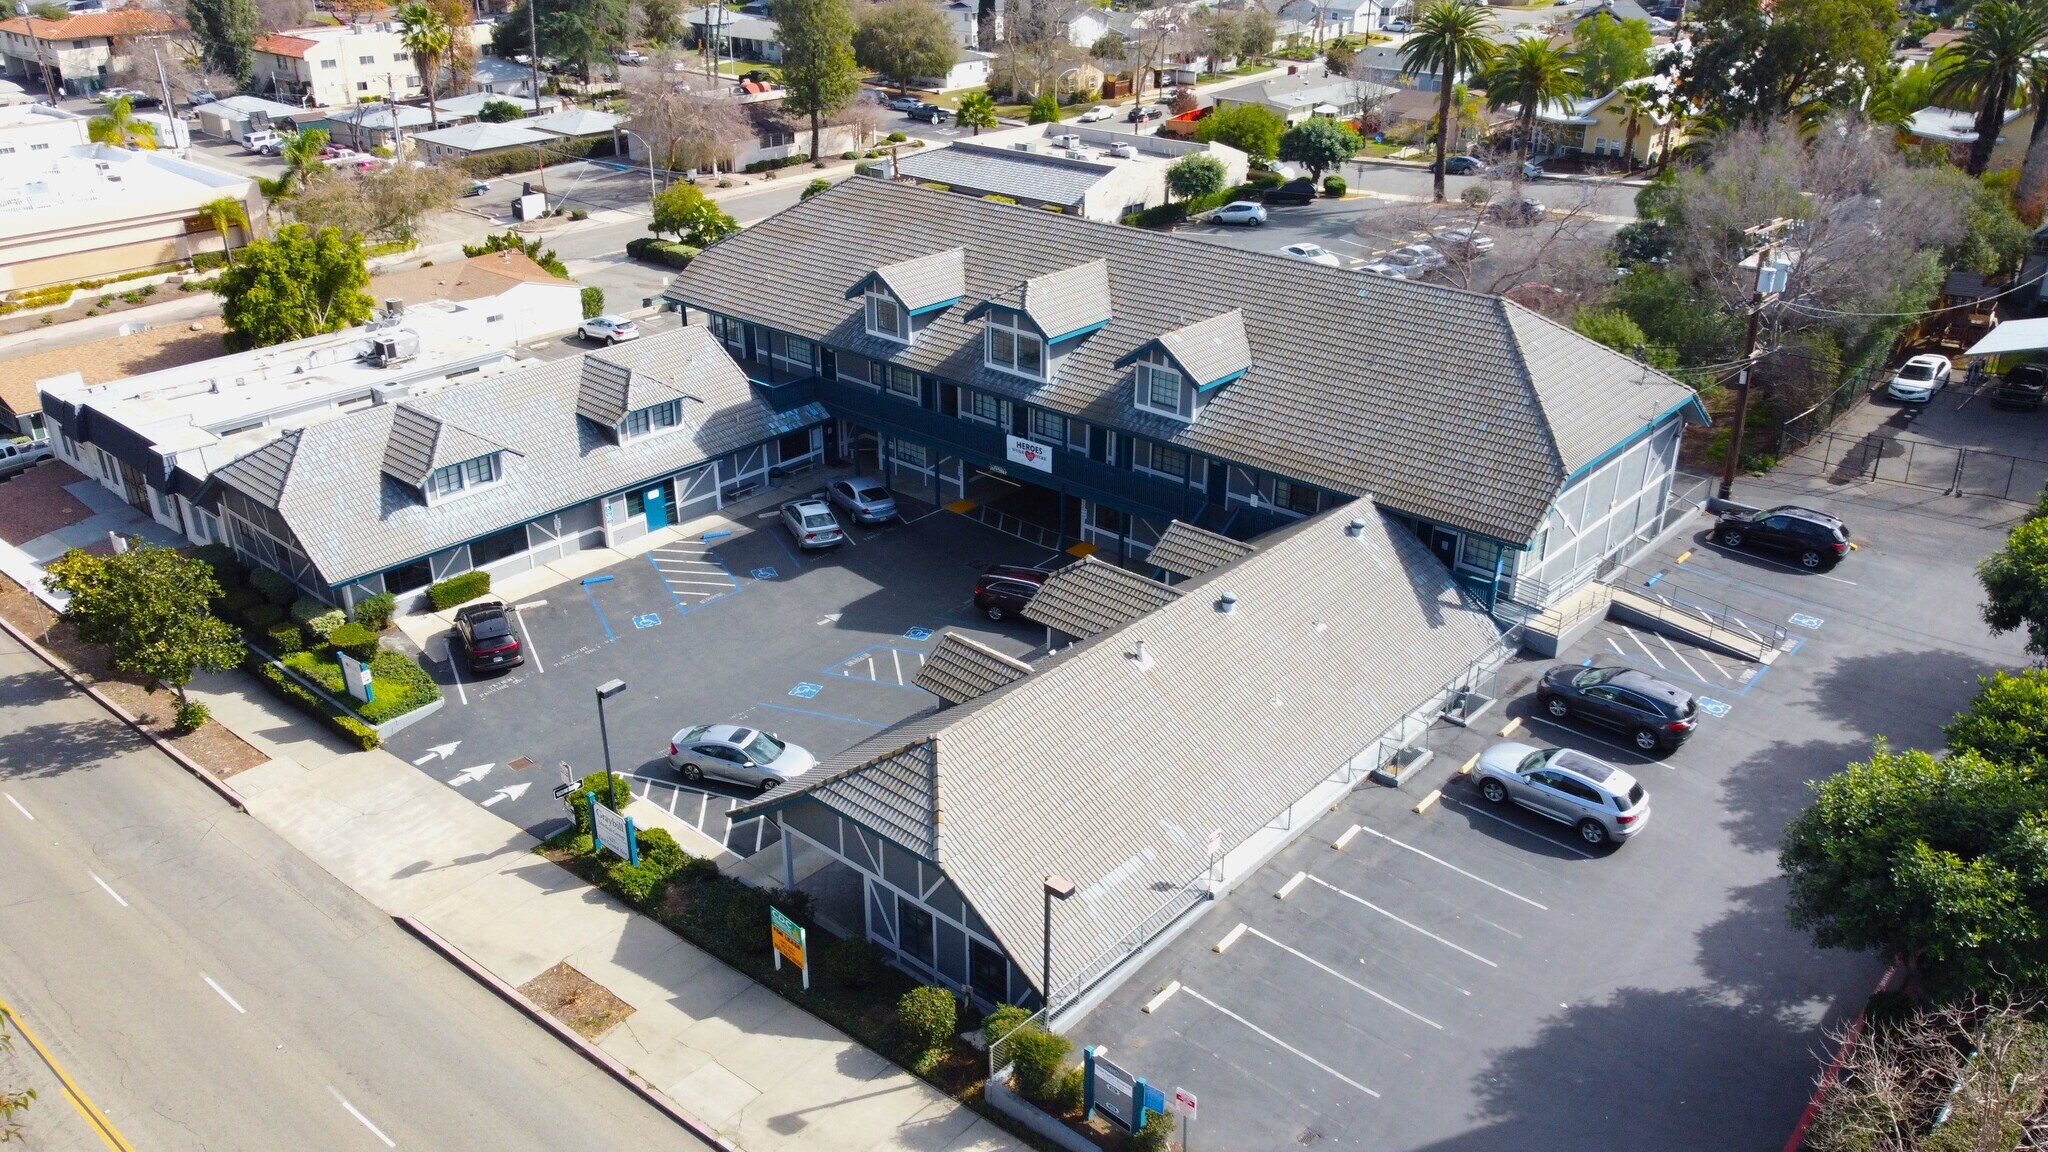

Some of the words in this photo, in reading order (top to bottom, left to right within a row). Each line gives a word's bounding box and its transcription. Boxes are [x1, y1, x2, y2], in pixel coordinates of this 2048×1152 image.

[1016, 441, 1043, 454] HEROES
[596, 808, 624, 832] Graybill
[772, 910, 792, 929] CDC
